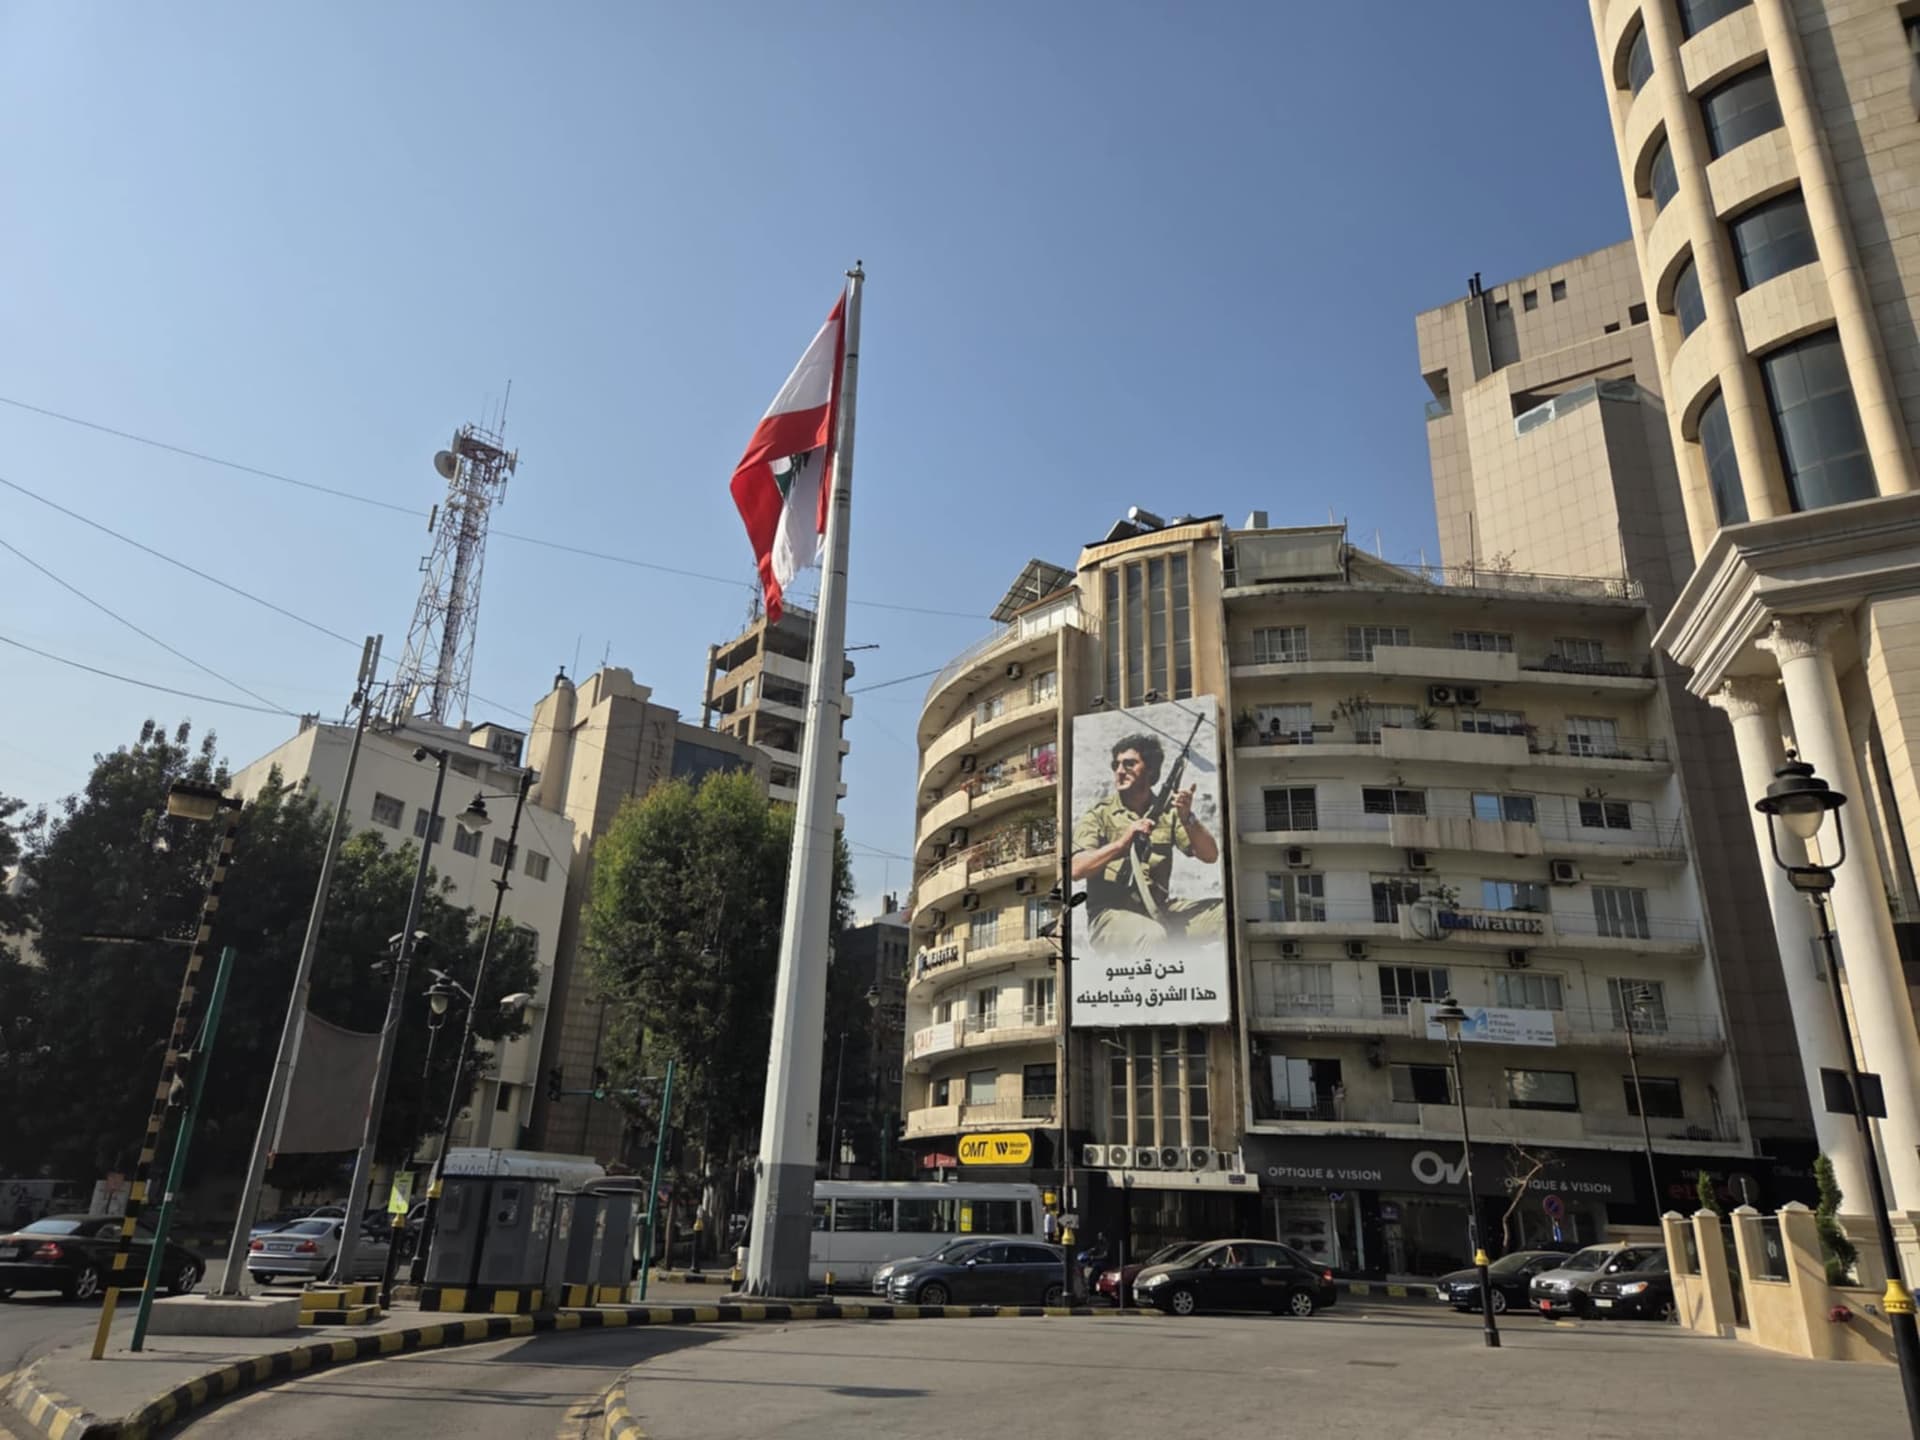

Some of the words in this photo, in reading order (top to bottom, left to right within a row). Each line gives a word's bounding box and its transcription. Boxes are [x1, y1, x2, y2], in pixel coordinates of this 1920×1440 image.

[1155, 961, 1184, 979] نحن
[1077, 987, 1142, 1007] وشياطينه
[1145, 986, 1187, 1007] الشرق
[1191, 987, 1216, 1001] هذا
[961, 1141, 989, 1158] OMT
[1268, 1166, 1324, 1179] OPTIQUE
[1326, 1169, 1335, 1179] &
[1337, 1169, 1382, 1181] VISION
[1504, 1179, 1559, 1191] OIQUE
[1560, 1180, 1568, 1191] &
[1570, 1181, 1612, 1193] VISION
